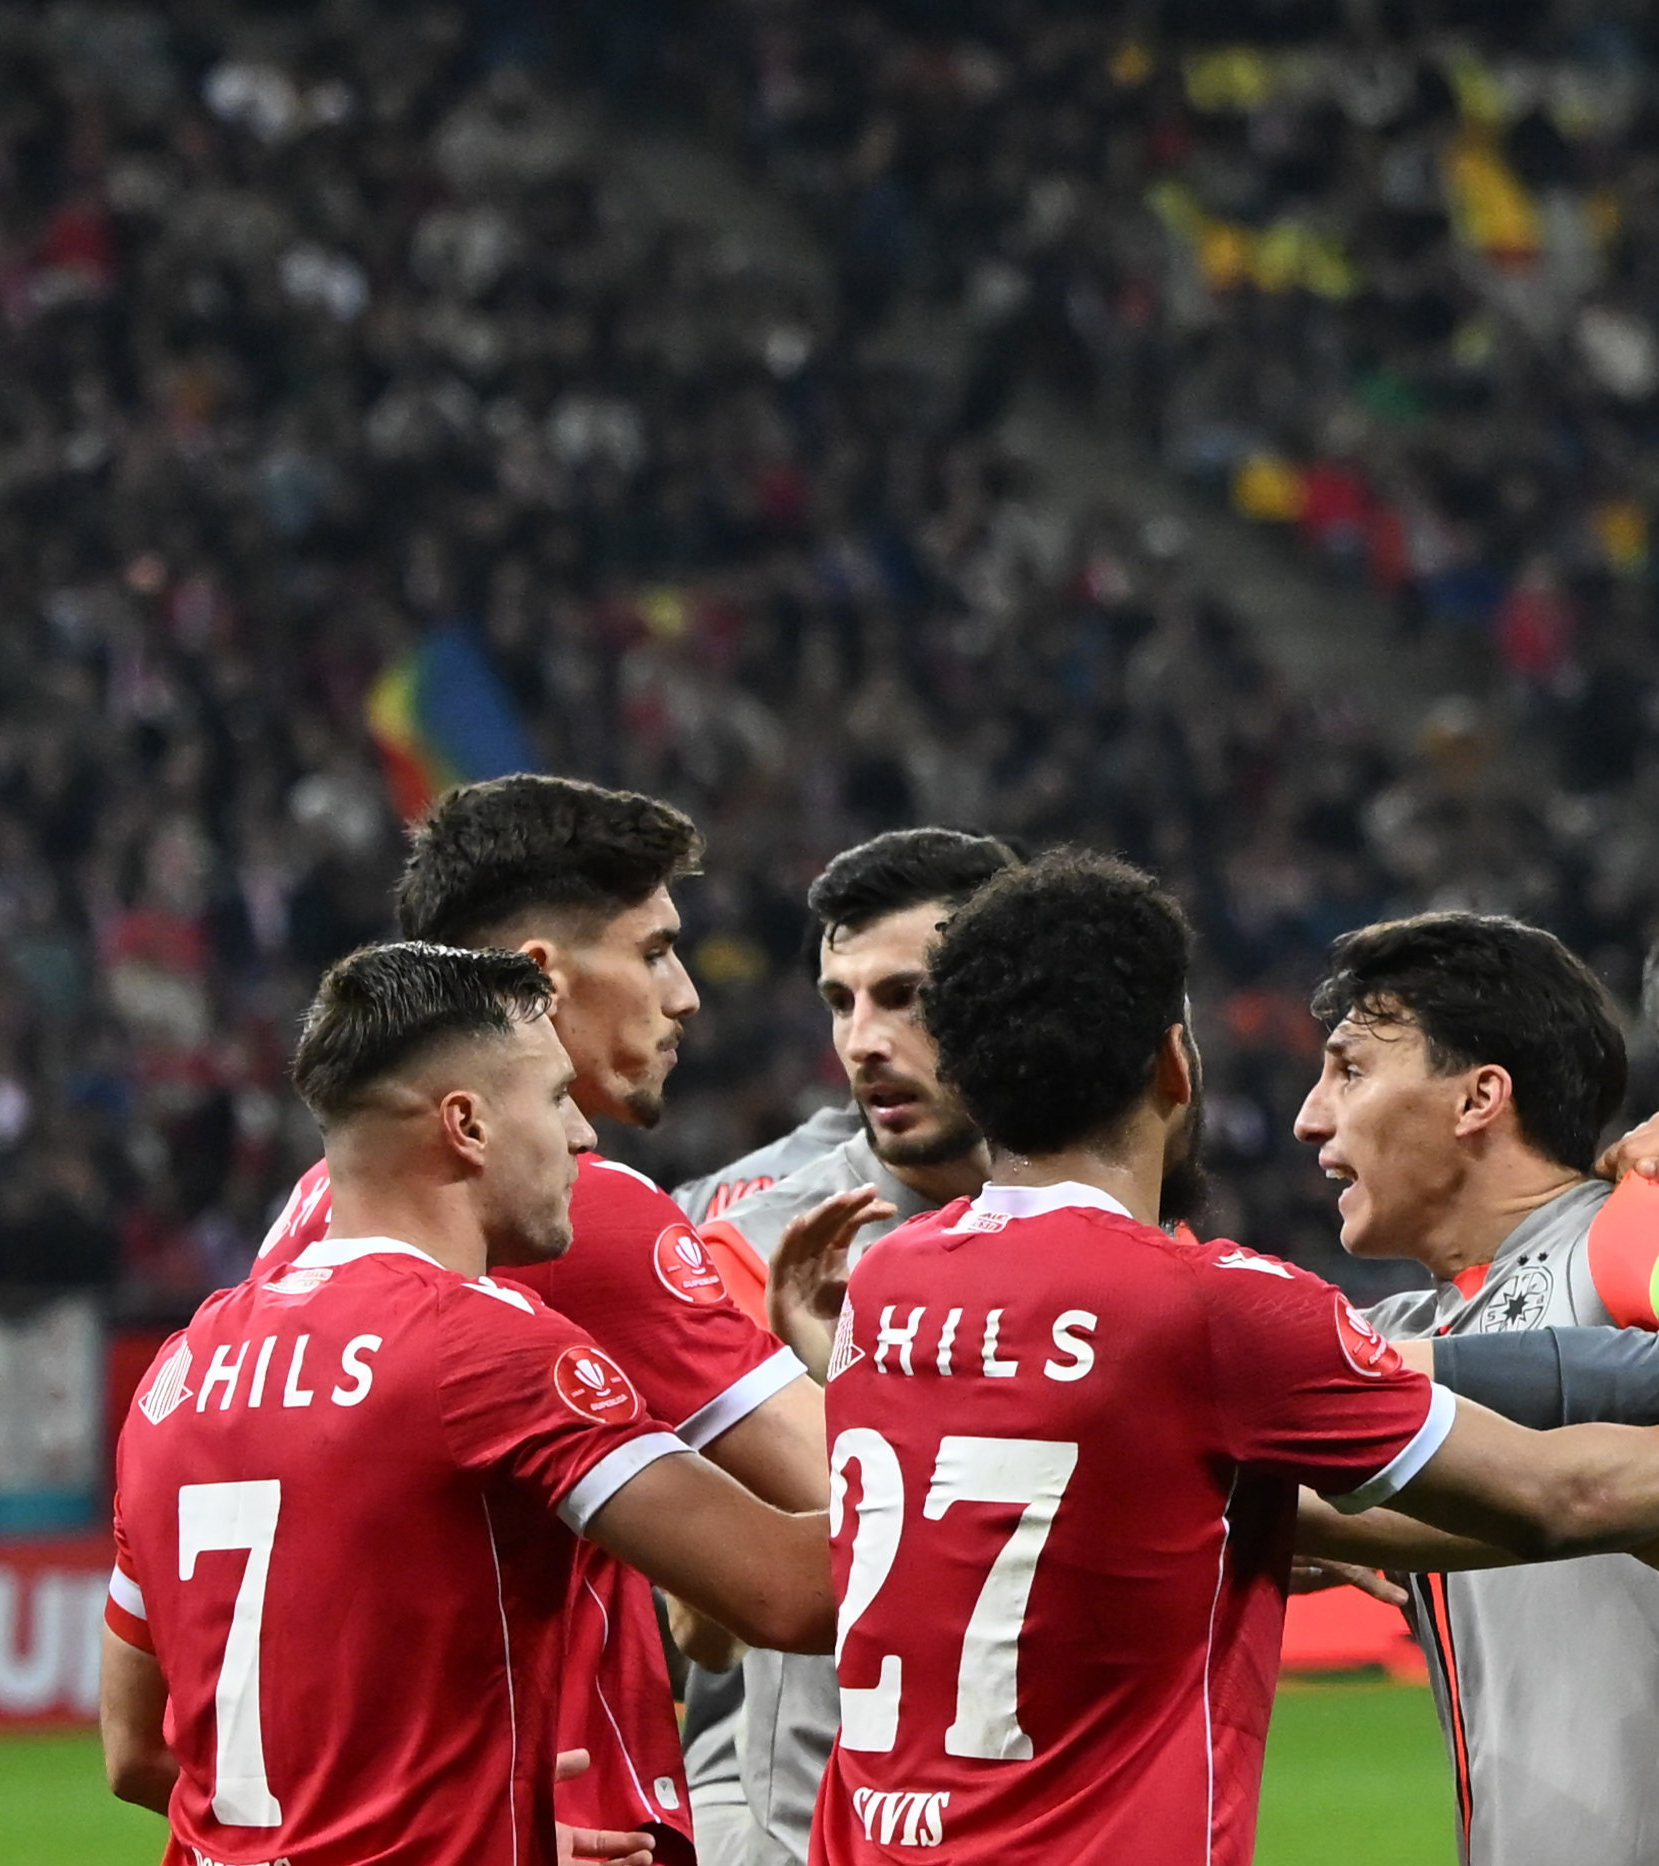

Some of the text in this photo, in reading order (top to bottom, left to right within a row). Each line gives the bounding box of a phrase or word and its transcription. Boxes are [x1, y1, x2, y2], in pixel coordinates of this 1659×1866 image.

[195, 1333, 384, 1413] HILS
[874, 1304, 1100, 1383] HILS
[177, 1478, 283, 1828] 7
[829, 1426, 1080, 1761] 27
